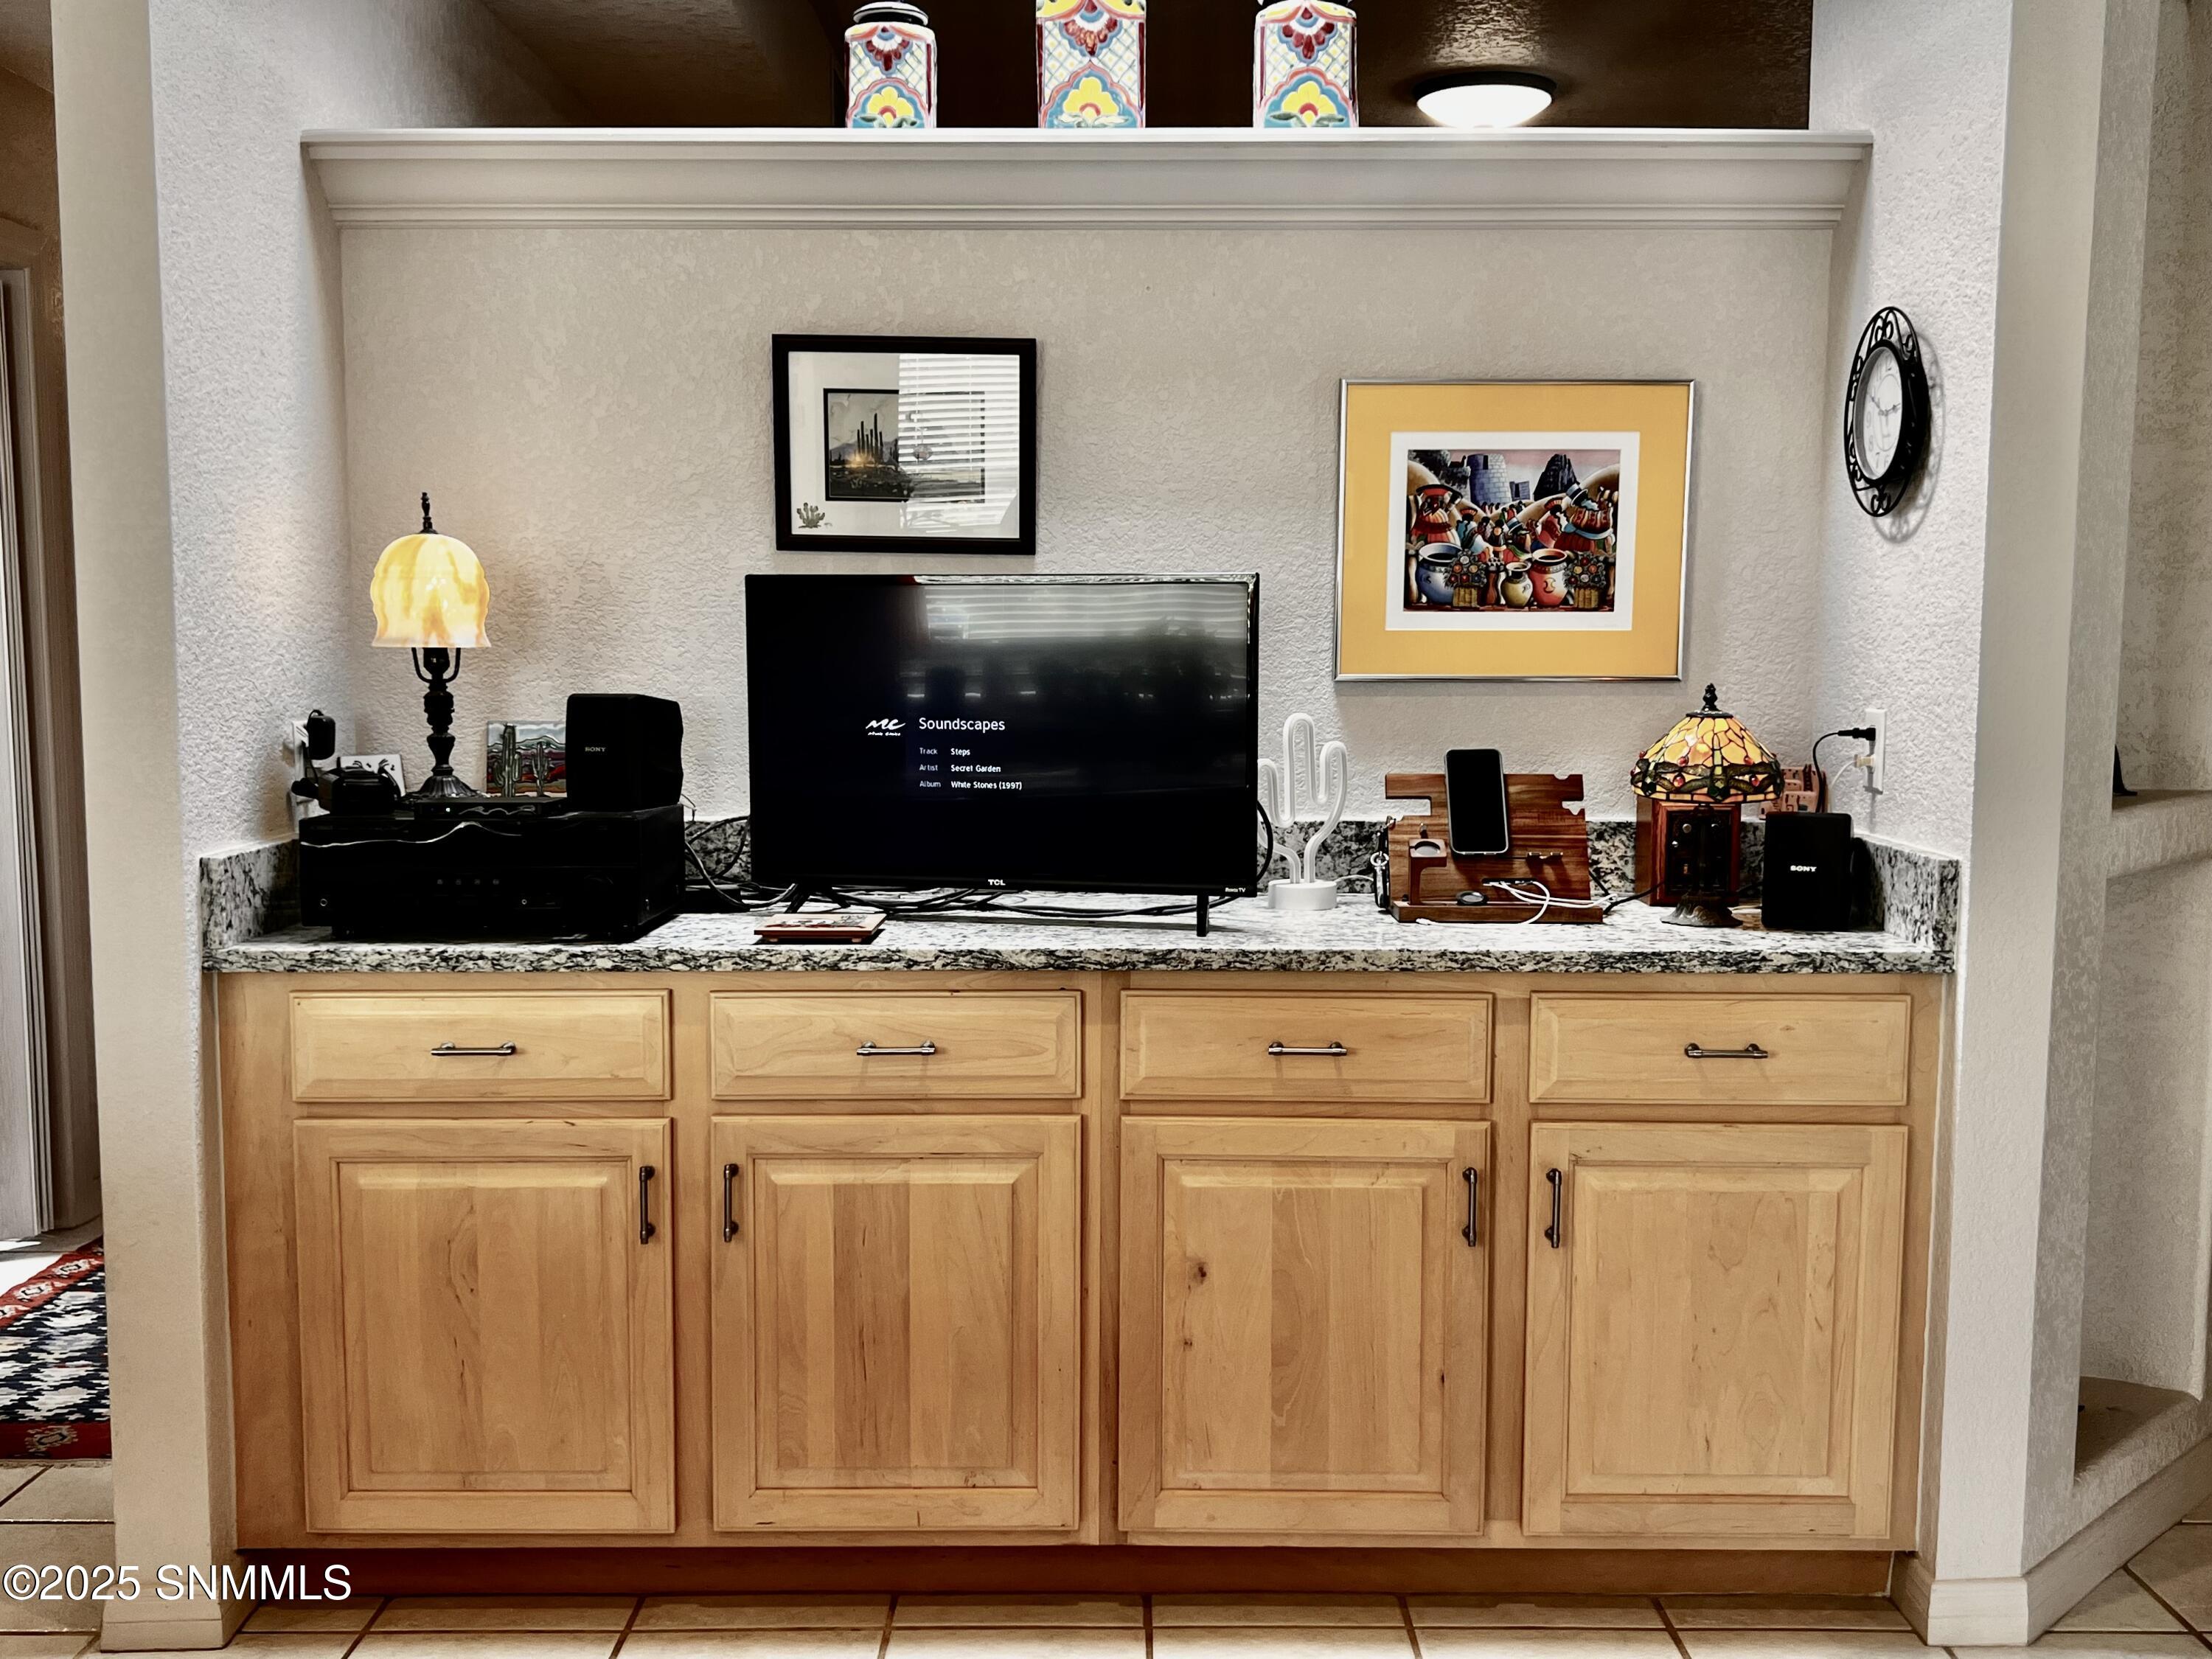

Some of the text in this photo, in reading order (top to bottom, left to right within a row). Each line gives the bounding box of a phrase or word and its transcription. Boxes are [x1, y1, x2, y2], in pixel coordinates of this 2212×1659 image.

[919, 717, 1006, 734] Soundscapes
[950, 748, 970, 757] Steps
[975, 765, 1001, 773] Garden
[973, 782, 997, 790] Stones
[998, 782, 1022, 790] (1997)
